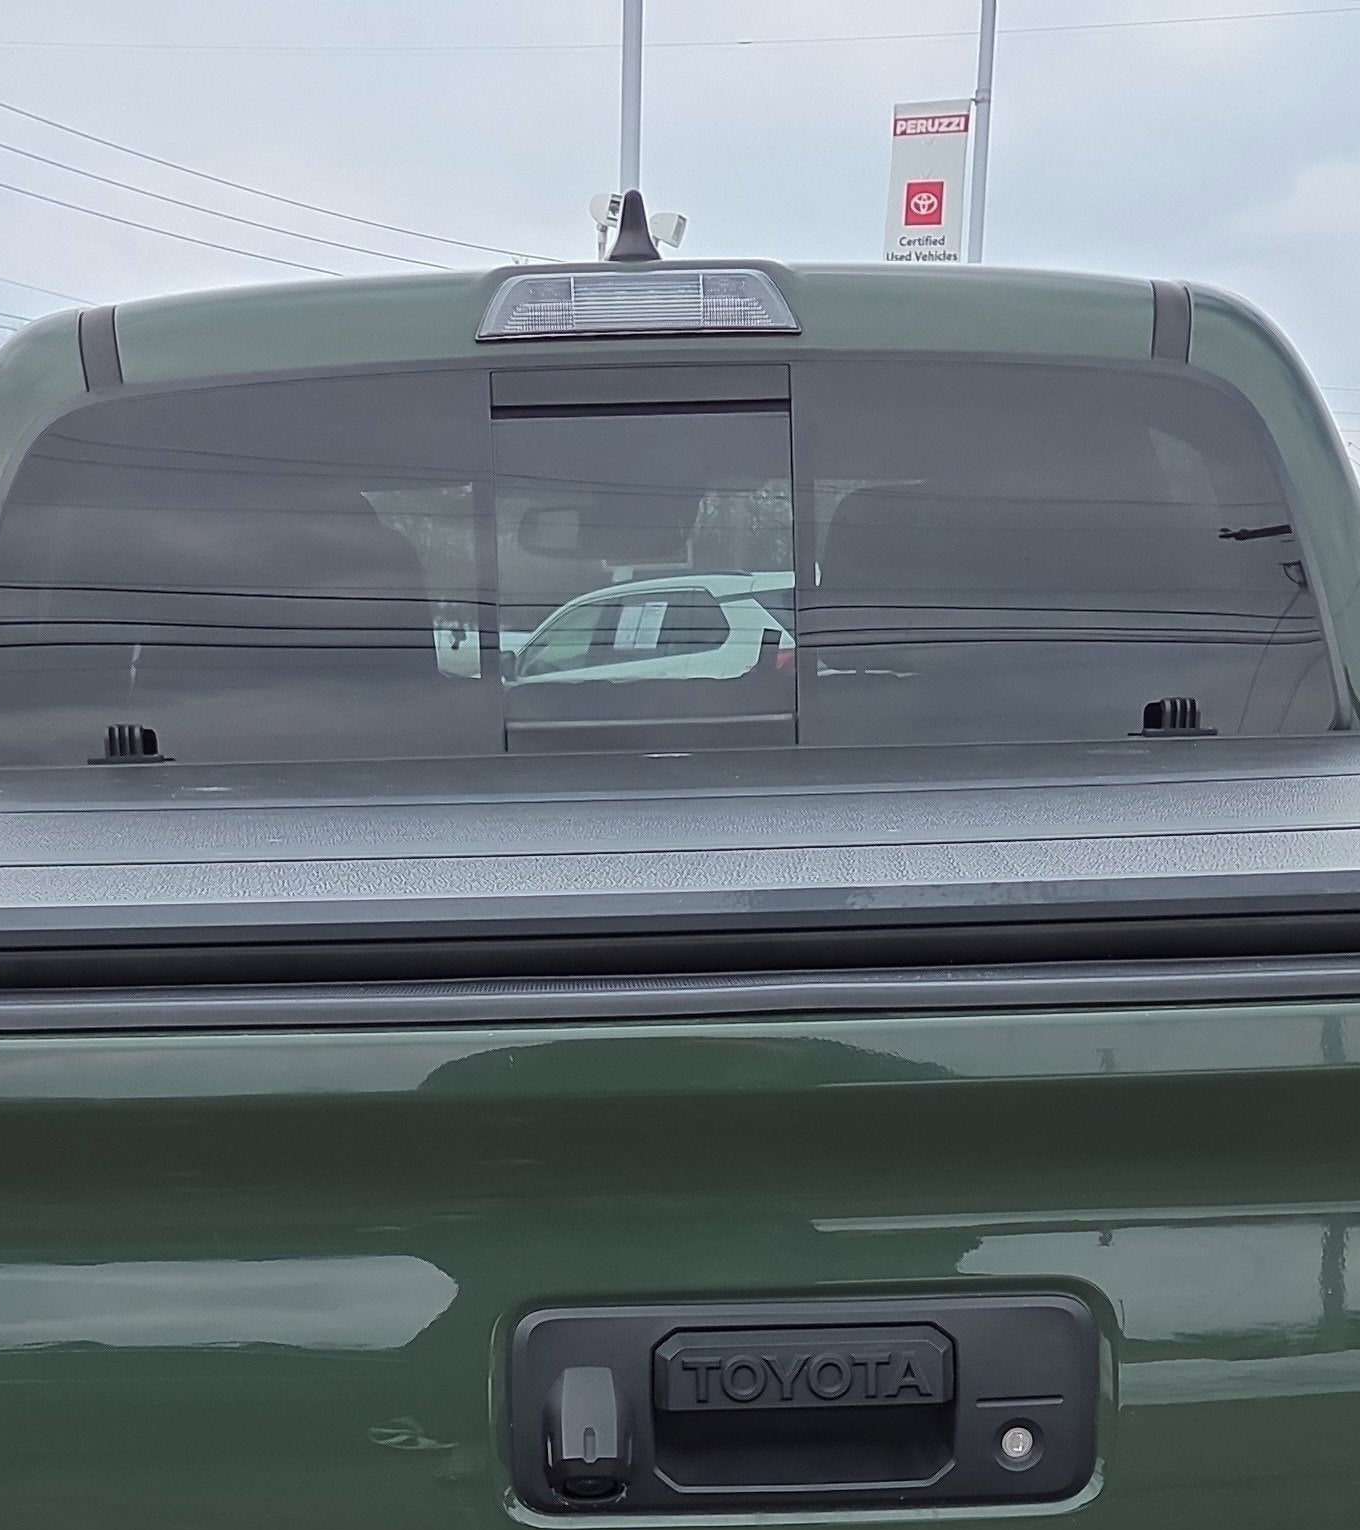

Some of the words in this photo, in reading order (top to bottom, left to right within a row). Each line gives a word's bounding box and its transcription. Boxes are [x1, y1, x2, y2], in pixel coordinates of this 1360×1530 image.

[895, 116, 965, 135] PERUZZI
[899, 235, 945, 247] Certified
[886, 251, 912, 262] Used
[914, 250, 958, 262] Vehicles
[681, 1349, 933, 1403] TOYOTA
